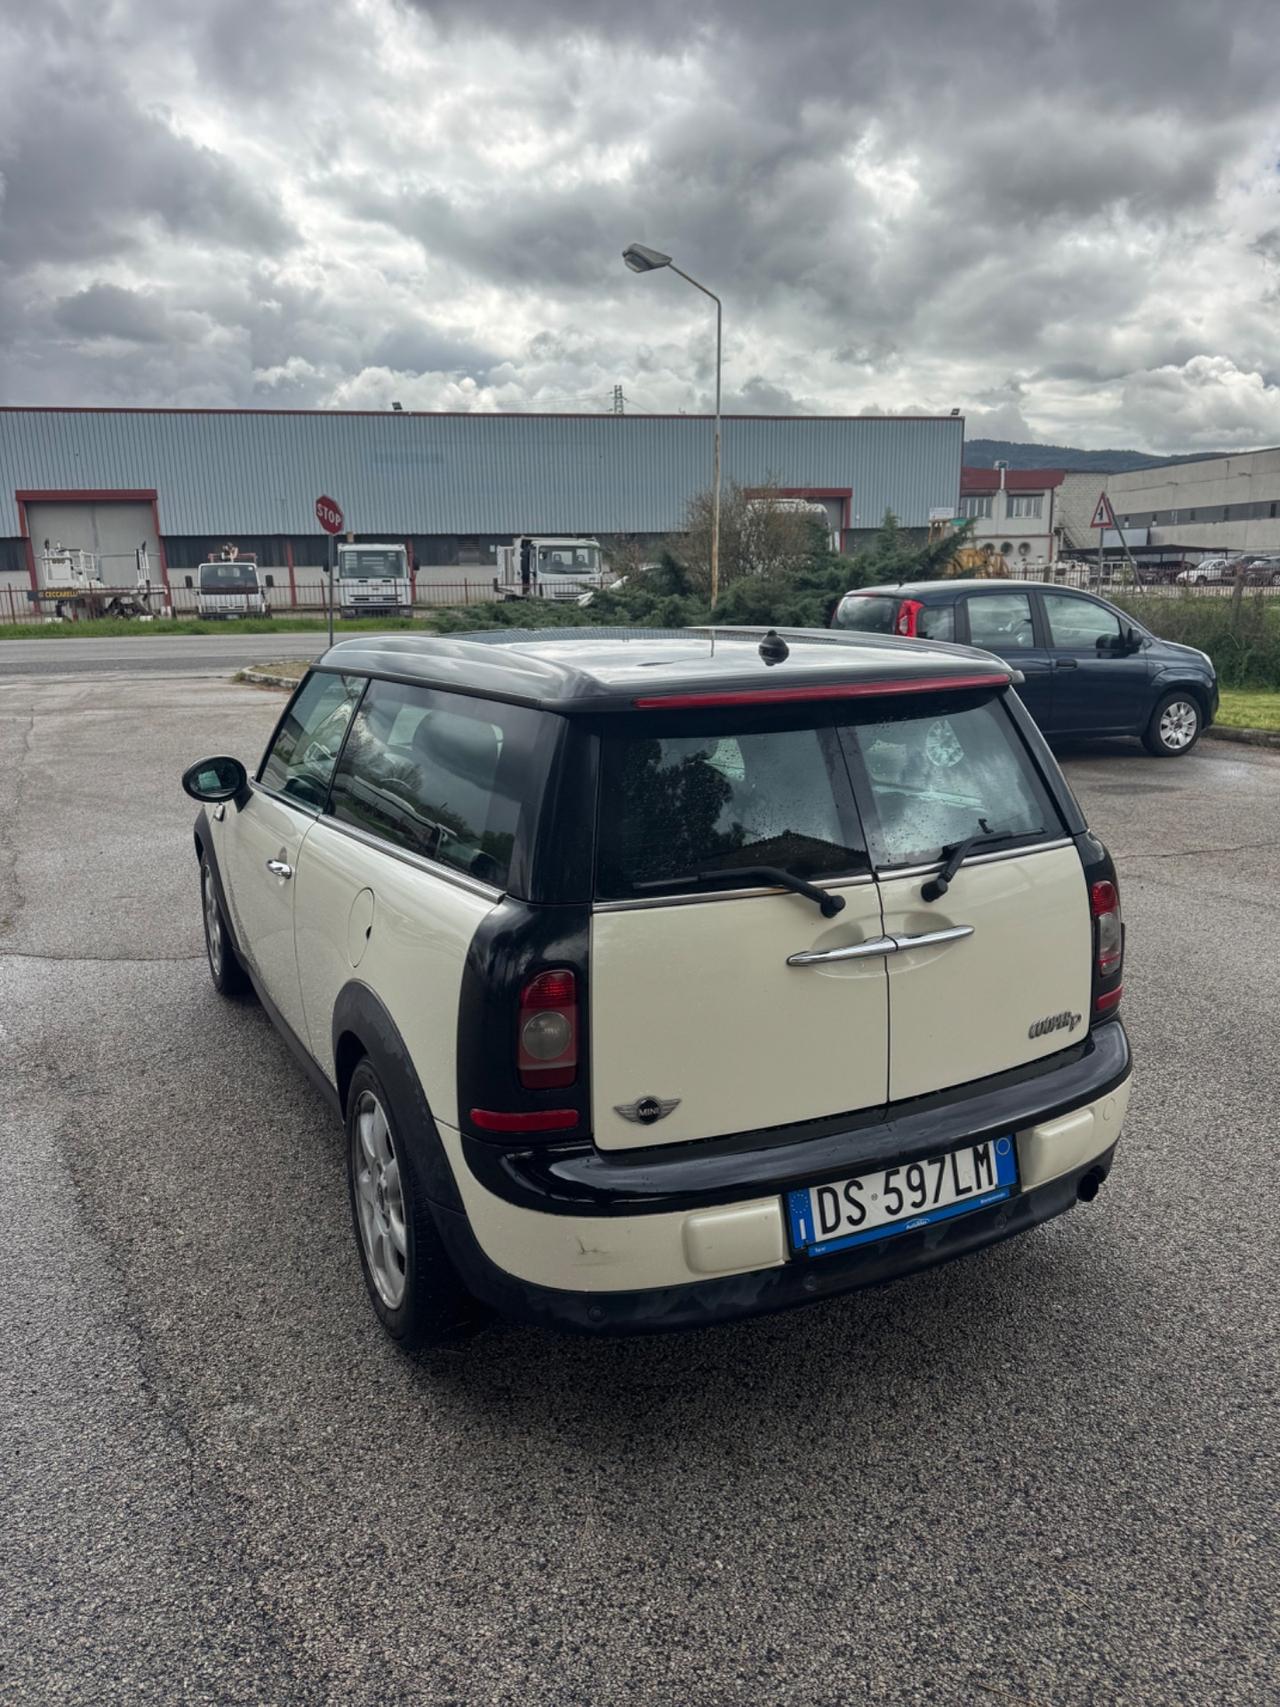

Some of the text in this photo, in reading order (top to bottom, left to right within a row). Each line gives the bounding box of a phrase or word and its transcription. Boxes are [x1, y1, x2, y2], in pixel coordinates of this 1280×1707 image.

[316, 503, 342, 527] STOP
[816, 1142, 994, 1235] DS 597LM
